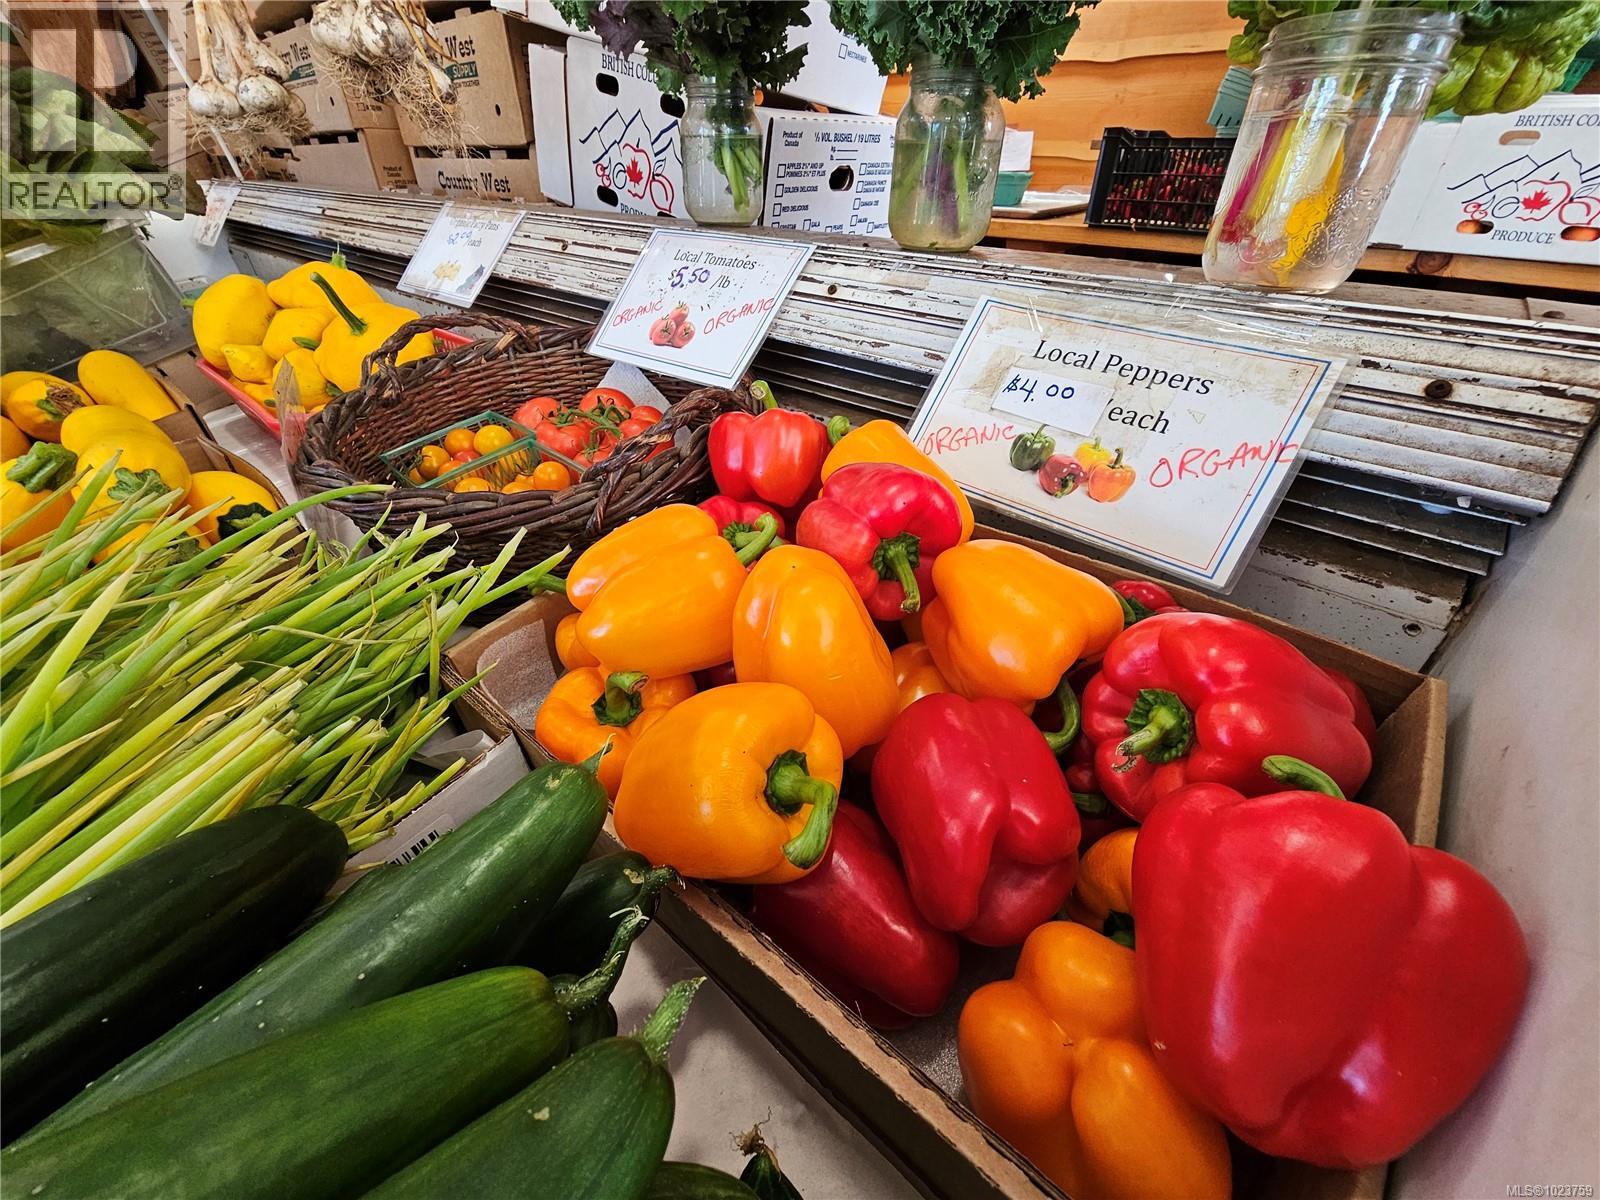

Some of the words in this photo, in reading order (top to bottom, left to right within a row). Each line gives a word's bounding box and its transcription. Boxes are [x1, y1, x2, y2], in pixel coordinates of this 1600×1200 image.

[453, 62, 476, 78] SUPPLY
[601, 53, 634, 78] BRITISH
[1514, 114, 1575, 127] BRITISH
[821, 132, 832, 142] VOL.
[833, 133, 852, 143] BUSHEL
[858, 134, 865, 143] 19
[865, 134, 881, 143] LITRES
[438, 171, 478, 192] Country
[480, 172, 511, 193] West
[1491, 229, 1556, 245] PRODUCE
[673, 248, 702, 265] Local
[704, 250, 758, 271] Tomatoes
[668, 266, 711, 288] $5.50
[710, 274, 731, 290] /lb
[612, 300, 664, 328] ORGANIC
[703, 298, 775, 335] ORGANIC
[1032, 339, 1100, 371] Local
[1101, 354, 1215, 395] Peppers
[1002, 373, 1075, 403] $4.00
[924, 423, 1017, 456] ORGANIC
